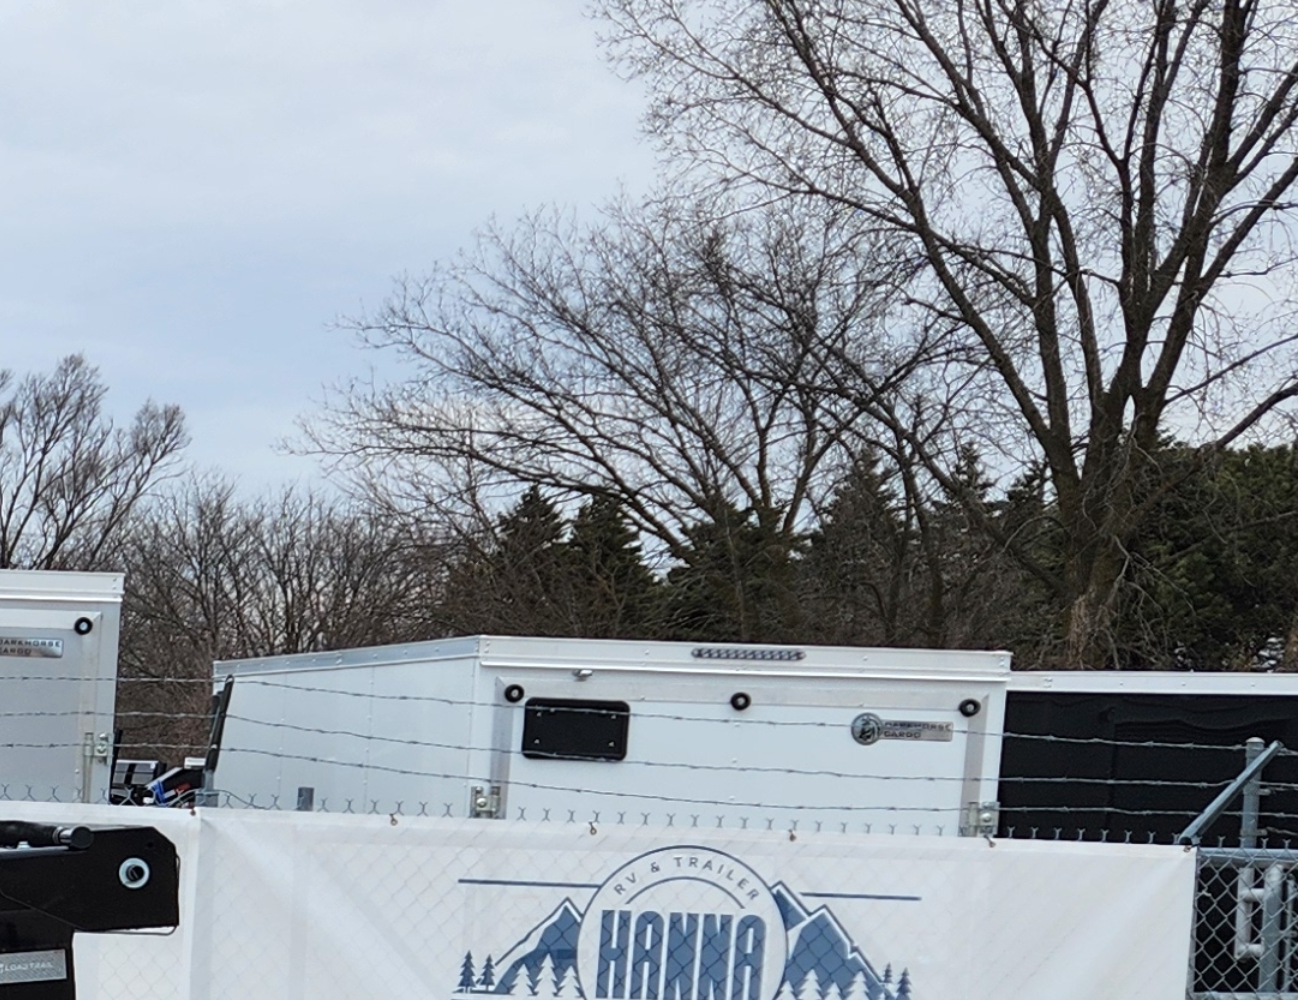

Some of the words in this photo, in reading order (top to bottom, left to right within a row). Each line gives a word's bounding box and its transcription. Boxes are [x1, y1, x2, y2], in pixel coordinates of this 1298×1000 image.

[613, 872, 638, 896] RV
[651, 861, 660, 873] &
[673, 856, 760, 900] TRAILER
[5, 962, 28, 972] LOAD
[28, 960, 54, 970] TRAIL
